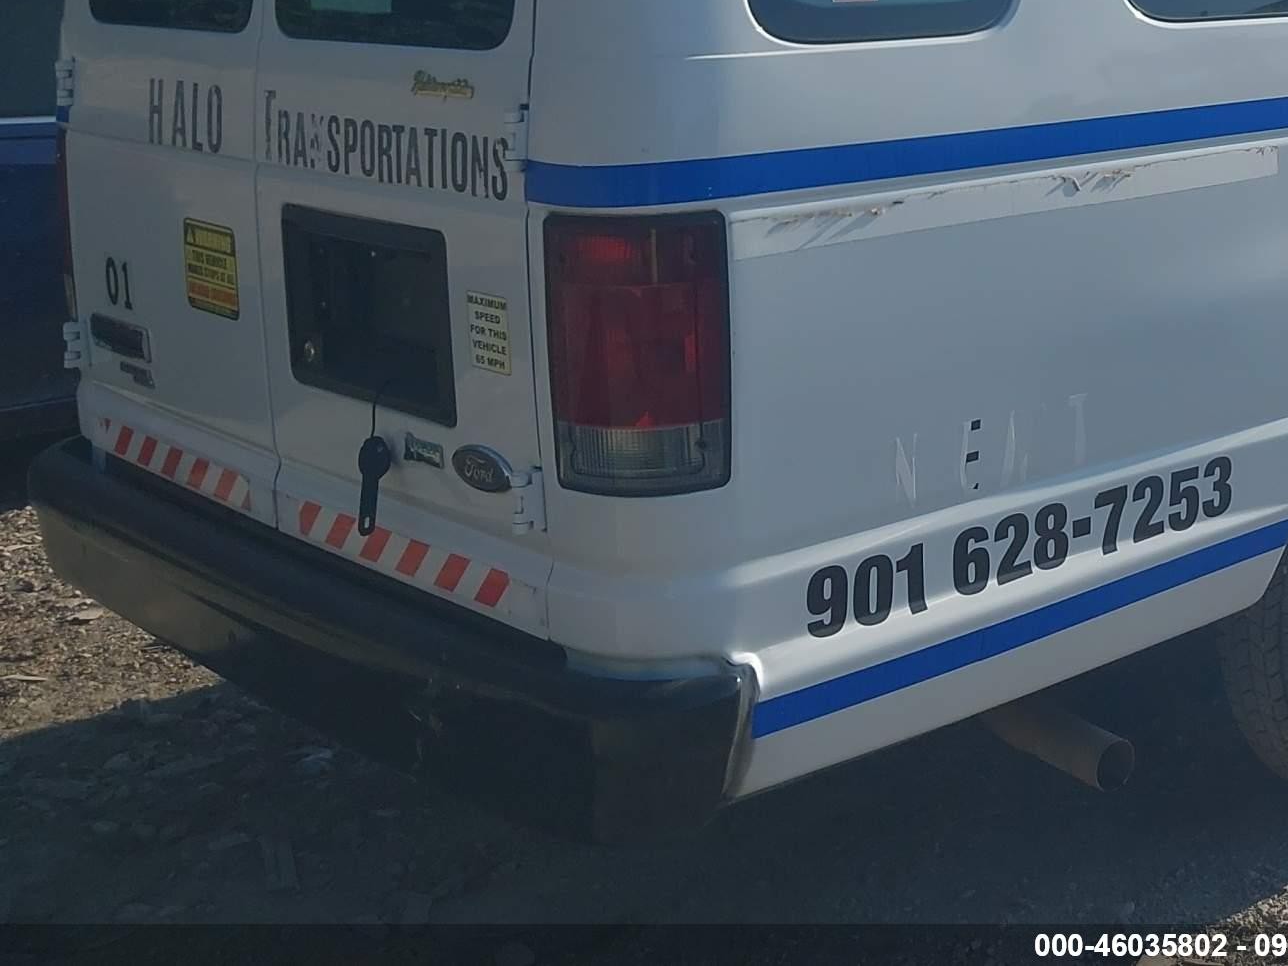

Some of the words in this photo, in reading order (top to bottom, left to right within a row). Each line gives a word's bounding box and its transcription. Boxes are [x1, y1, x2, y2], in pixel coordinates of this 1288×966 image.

[149, 77, 222, 154] HALO
[264, 89, 509, 201] TRANSPORTATIONS
[105, 257, 133, 310] 01
[466, 294, 507, 310] MAXIMUM
[474, 310, 501, 324] SPEED
[470, 324, 486, 335] FOR
[487, 328, 507, 341] THIS
[471, 338, 507, 355] VEHICLE
[487, 356, 506, 370] MPH
[464, 455, 495, 483] Ford
[806, 543, 929, 639] 901
[952, 455, 1233, 597] 628-7253
